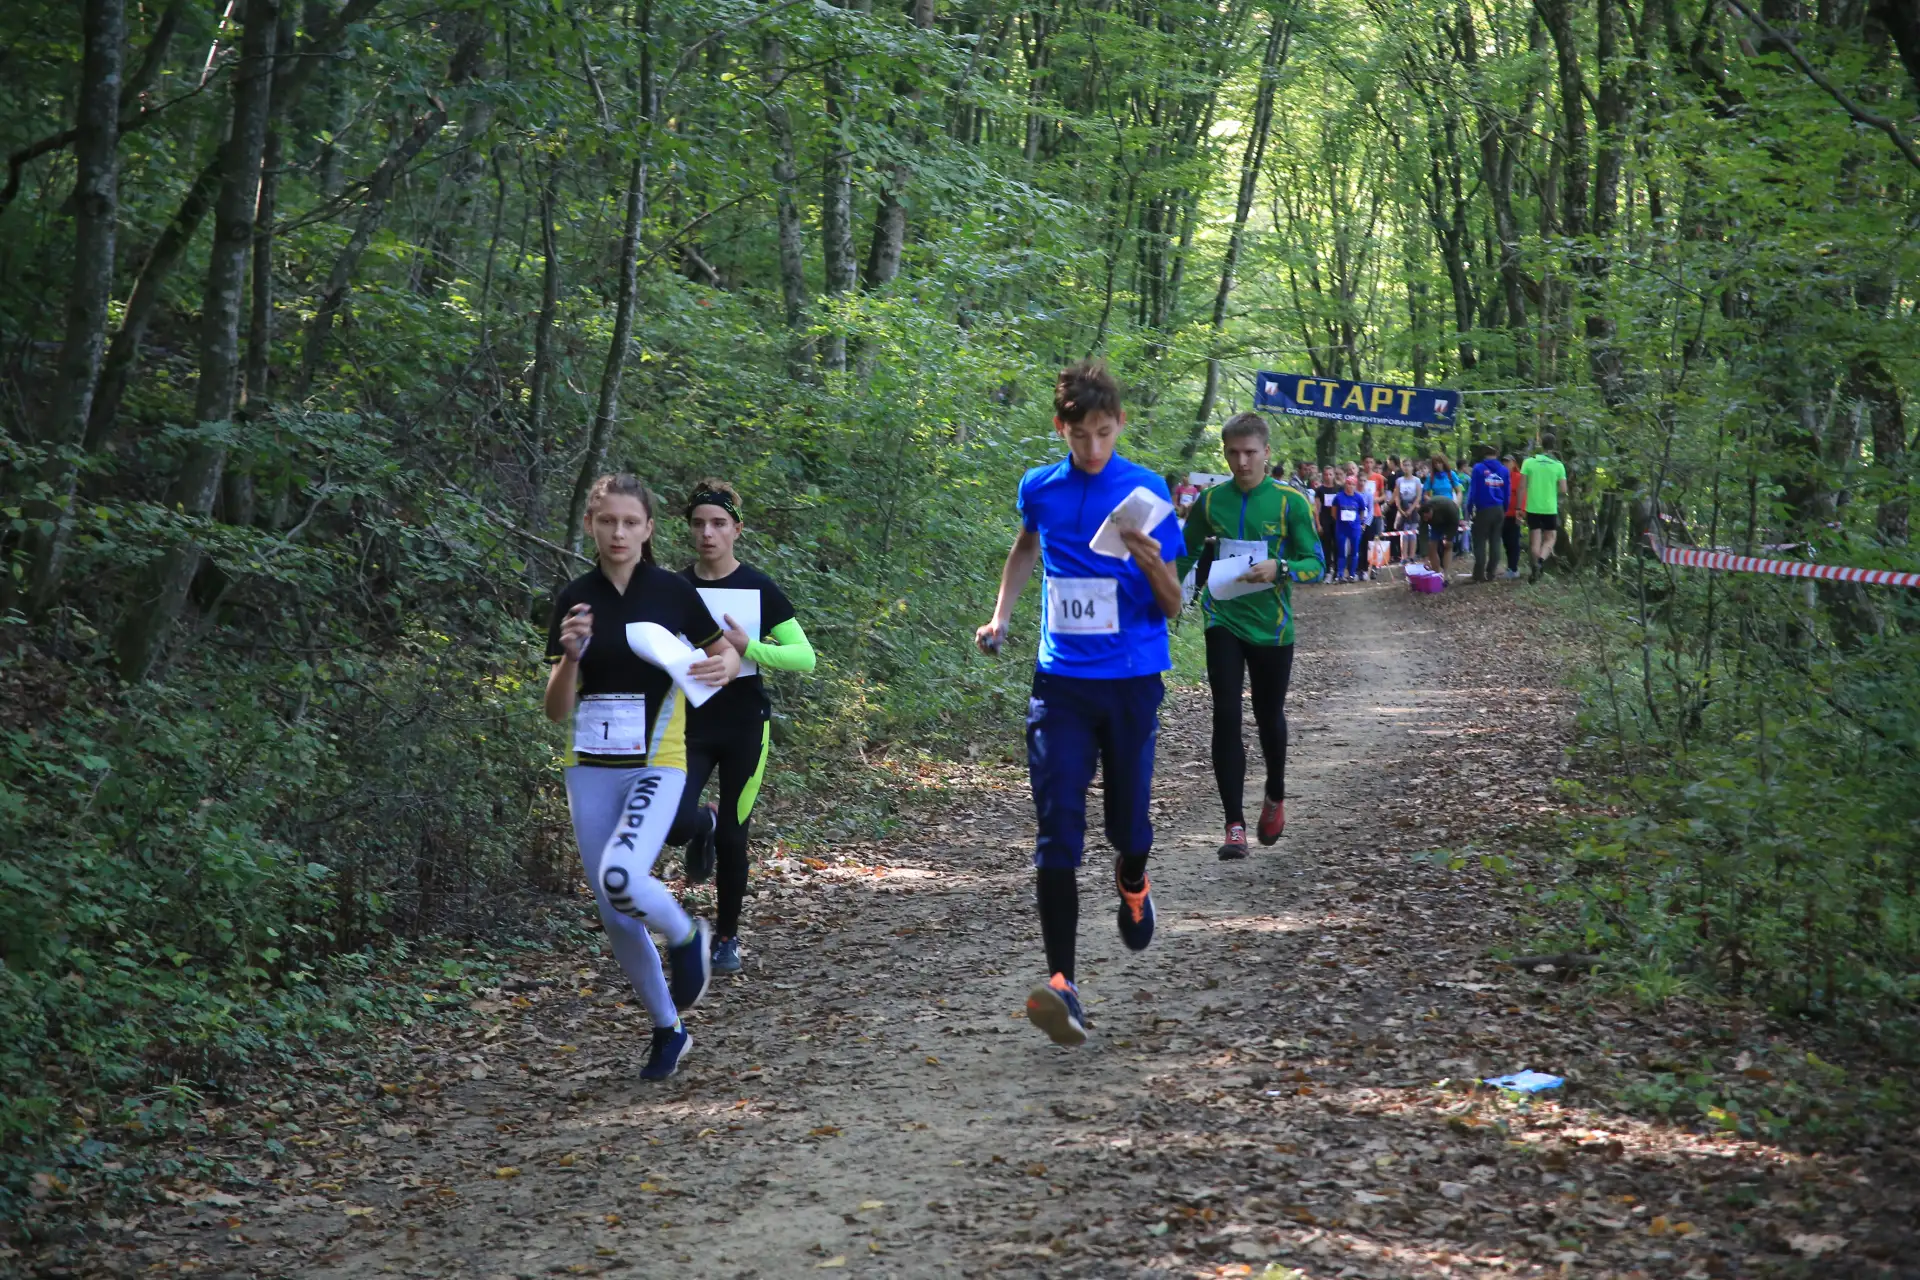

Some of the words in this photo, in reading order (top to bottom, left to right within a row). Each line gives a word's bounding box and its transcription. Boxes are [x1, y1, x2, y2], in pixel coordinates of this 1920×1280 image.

[1296, 379, 1417, 415] СТАРТ
[1286, 407, 1343, 420] СПОРТИВНОЕ
[1344, 414, 1423, 428] ОРИЕНТИРОВАНИЕ
[1062, 599, 1095, 619] 104
[602, 721, 609, 740] 1
